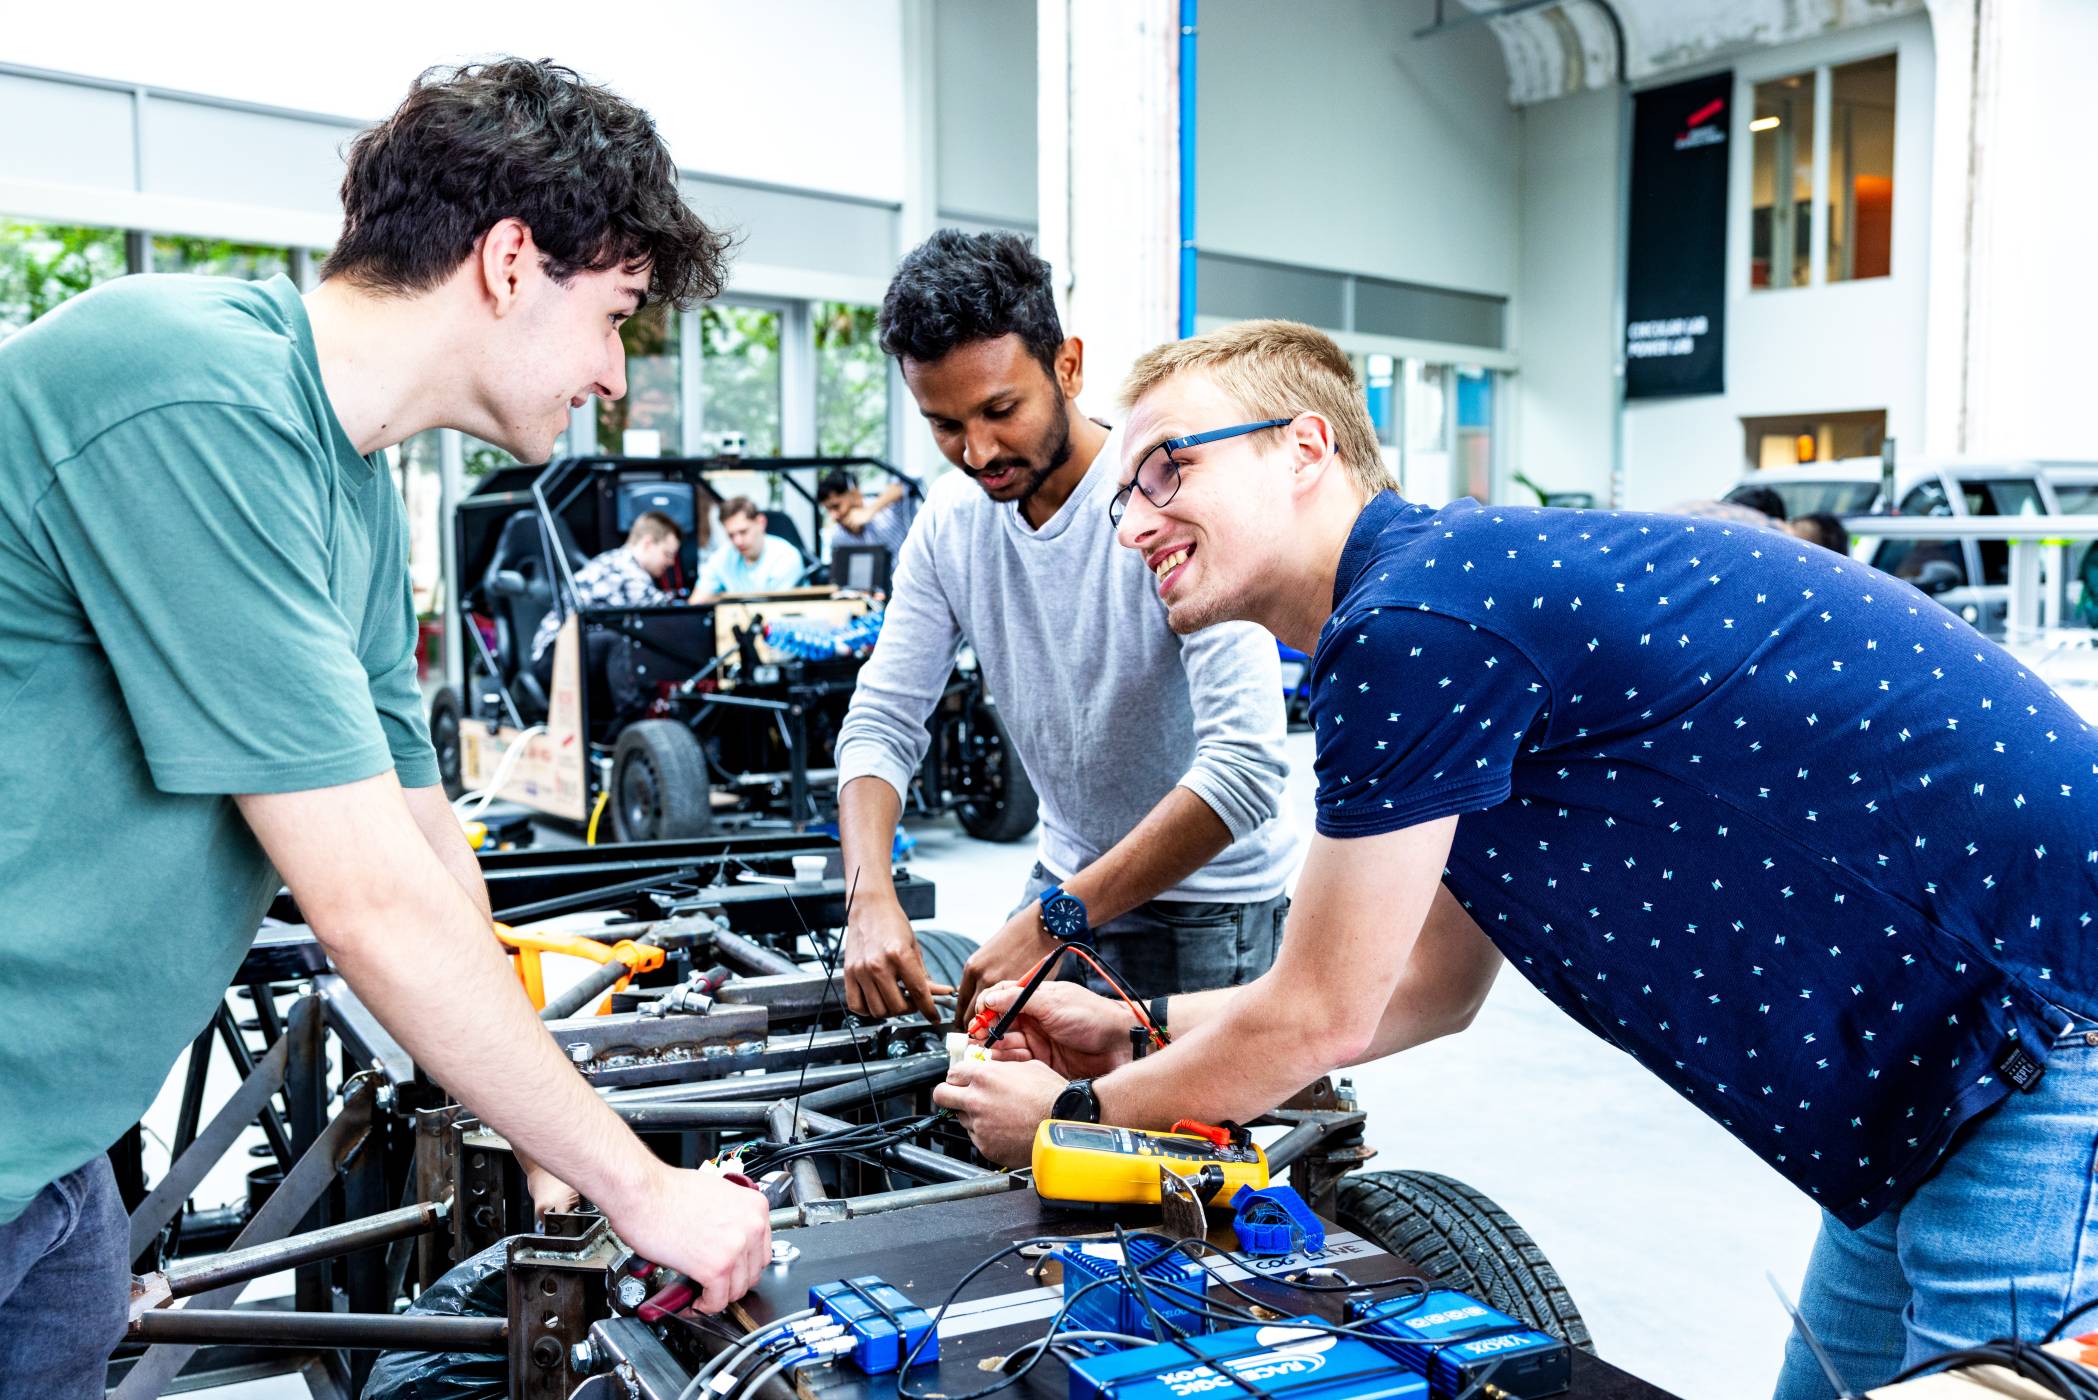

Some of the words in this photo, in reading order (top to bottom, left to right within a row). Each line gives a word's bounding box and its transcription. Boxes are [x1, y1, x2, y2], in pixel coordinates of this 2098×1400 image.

[1465, 1334, 1531, 1354] VBOX
[1156, 1366, 1226, 1385] BOX
[1171, 1360, 1306, 1396] RACEOGIC
